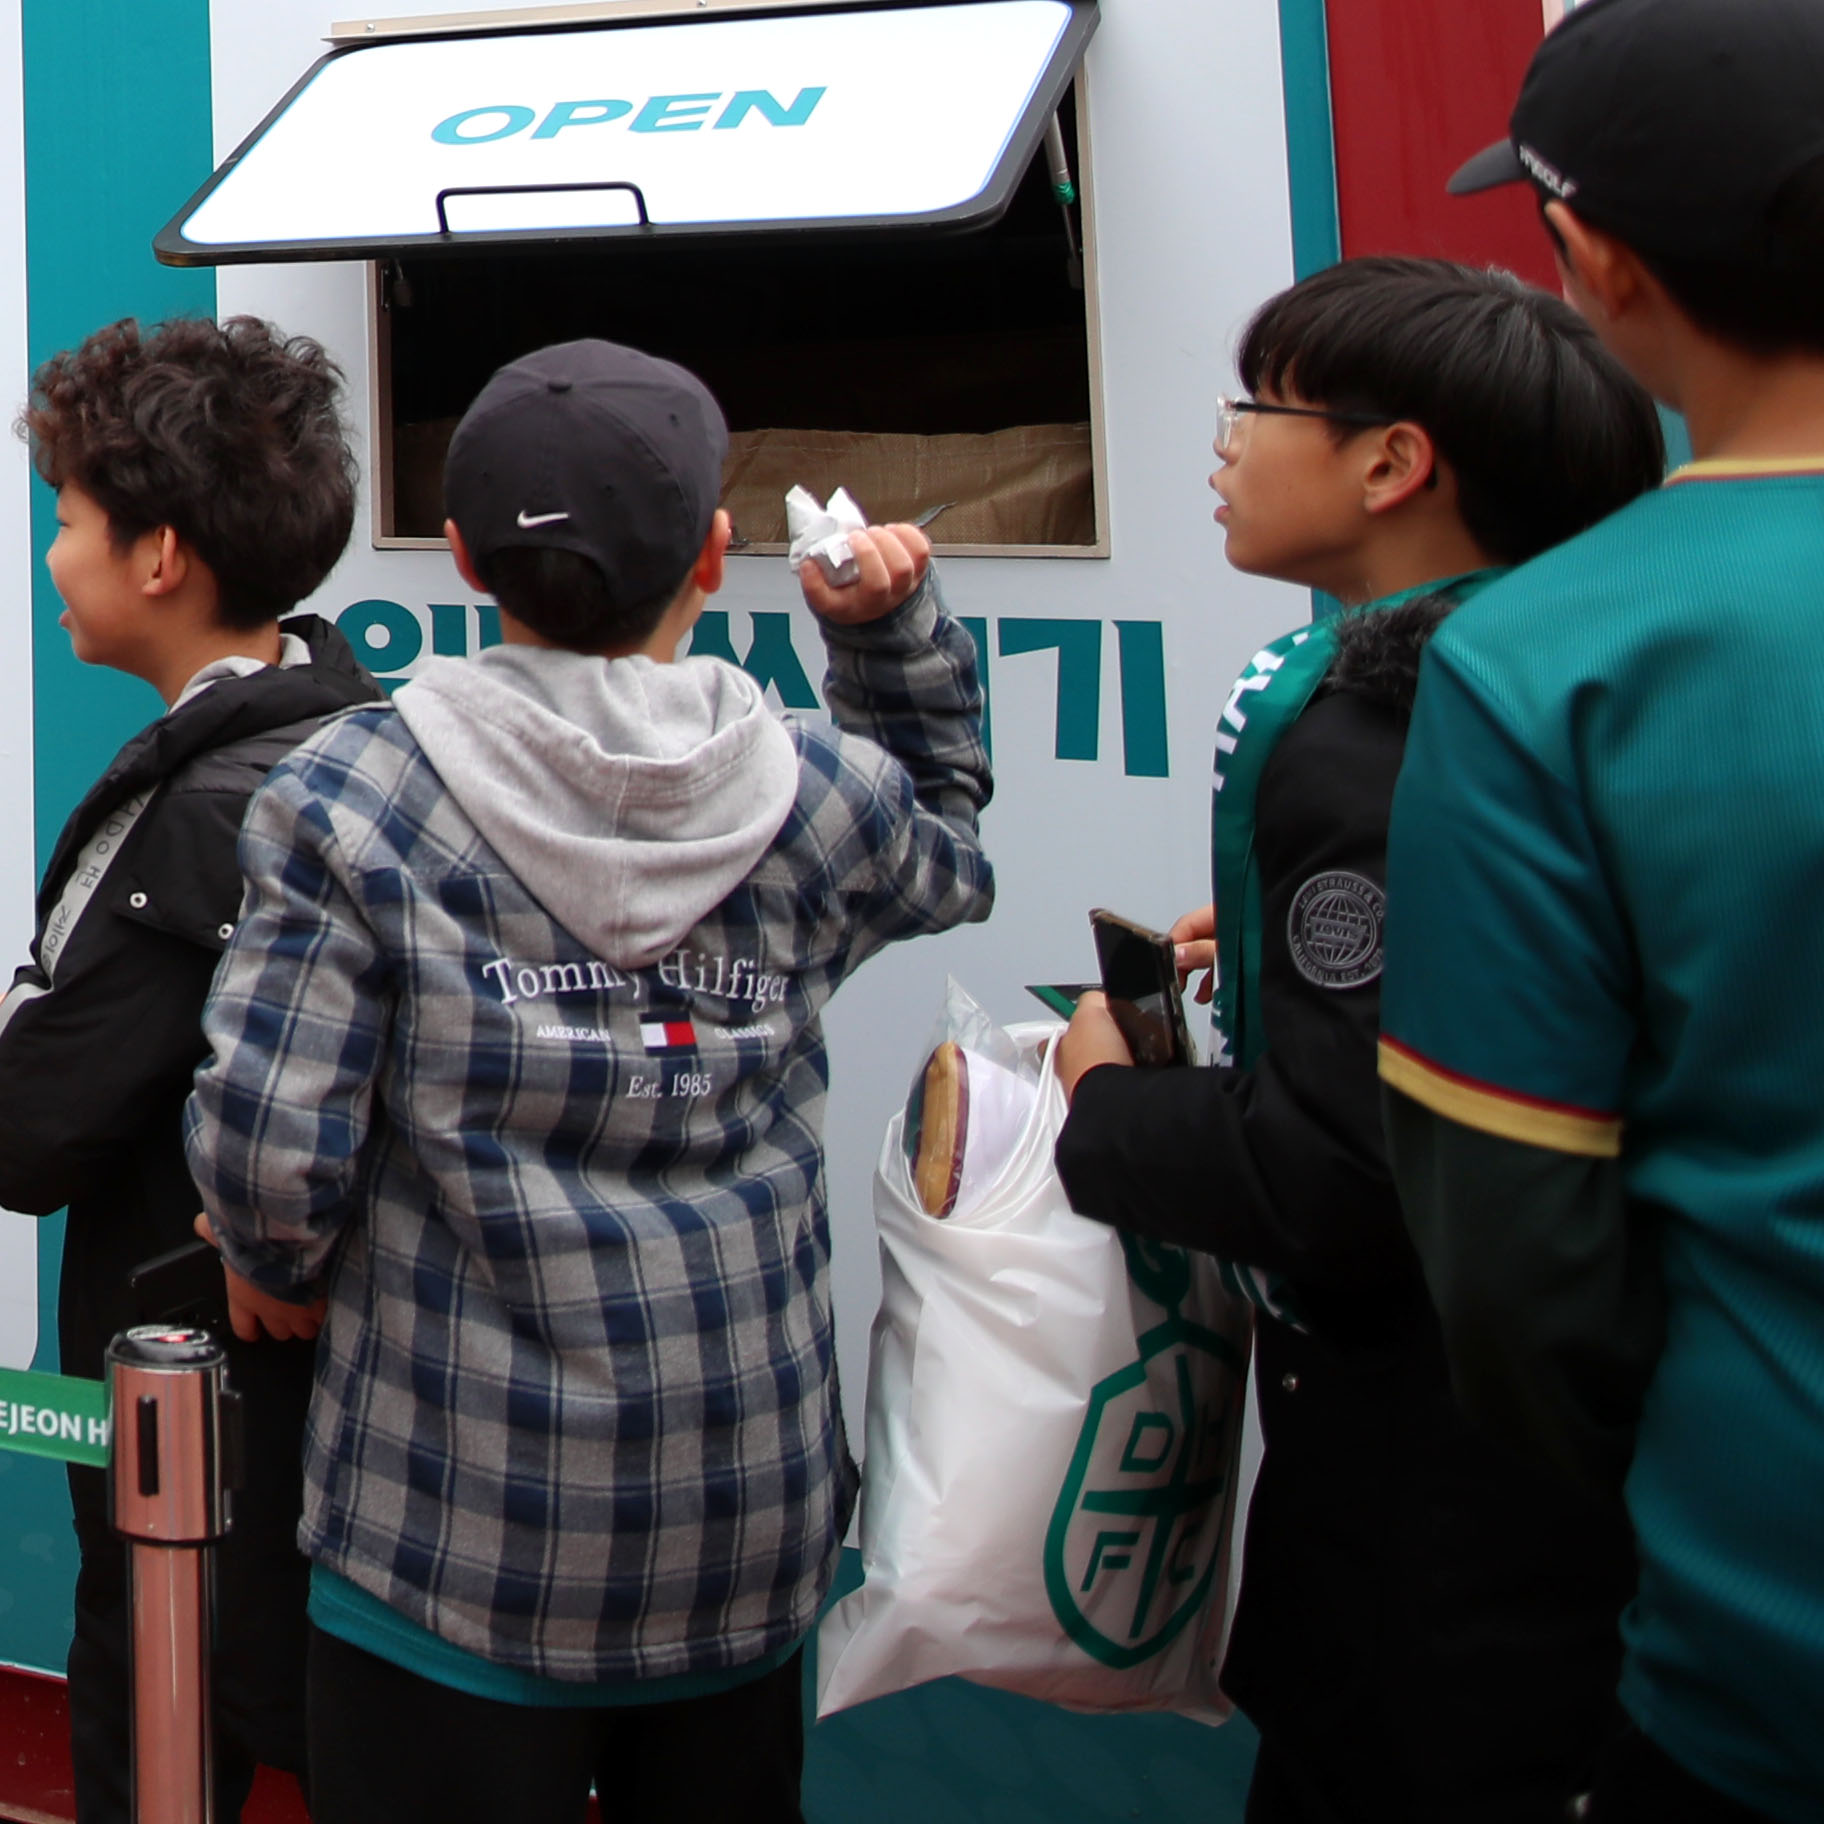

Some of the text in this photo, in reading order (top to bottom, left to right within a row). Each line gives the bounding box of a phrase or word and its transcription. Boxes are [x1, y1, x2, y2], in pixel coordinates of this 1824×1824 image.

[429, 86, 827, 145] OPEN
[1316, 877, 1364, 895] STRAUSS
[483, 949, 790, 1013] Tommy Hilfiger
[536, 1023, 611, 1043] AMERICAN
[625, 1072, 712, 1100] Est. 1985
